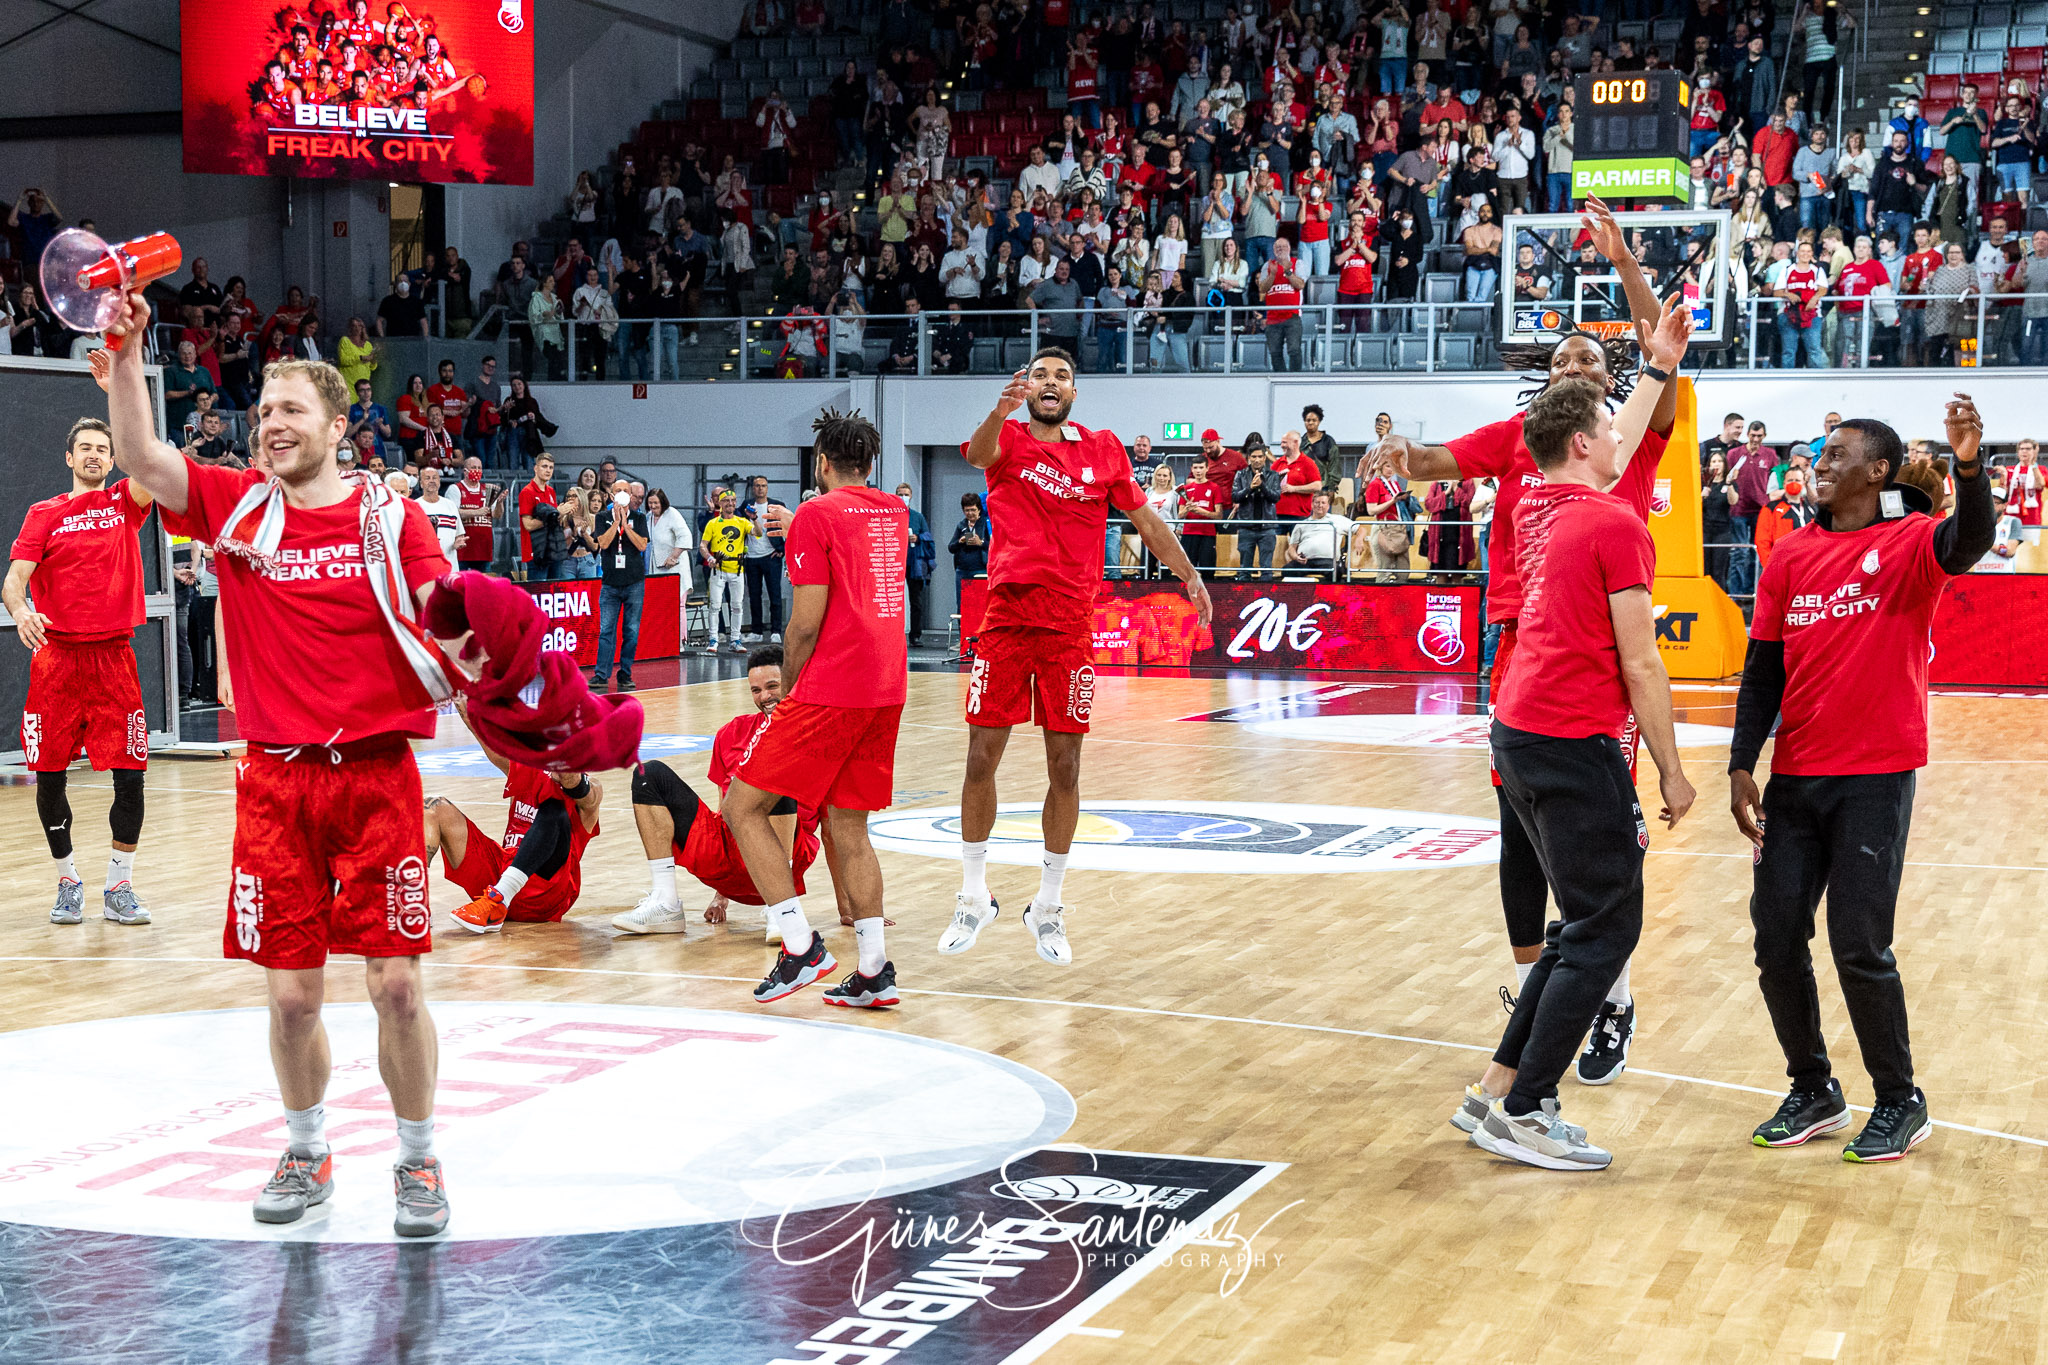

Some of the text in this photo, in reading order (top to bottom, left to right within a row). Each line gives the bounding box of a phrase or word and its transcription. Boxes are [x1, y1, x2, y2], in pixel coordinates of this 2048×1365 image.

[295, 104, 427, 131] BELIEVE
[355, 129, 367, 138] IN
[267, 135, 455, 162] FREAK CITY
[1576, 169, 1671, 188] BARMER
[1517, 320, 1538, 329] BBL
[1020, 468, 1065, 499] FREAK
[1035, 461, 1084, 494] BELIEE
[98, 514, 125, 529] CITY
[326, 563, 365, 578] CIT
[1426, 593, 1462, 604] brose
[1832, 597, 1880, 618] CITY
[1226, 597, 1332, 658] 20€
[1065, 669, 1076, 717] AUTOMATION
[233, 866, 262, 954] SIXT
[385, 865, 396, 931] AUTOMATION
